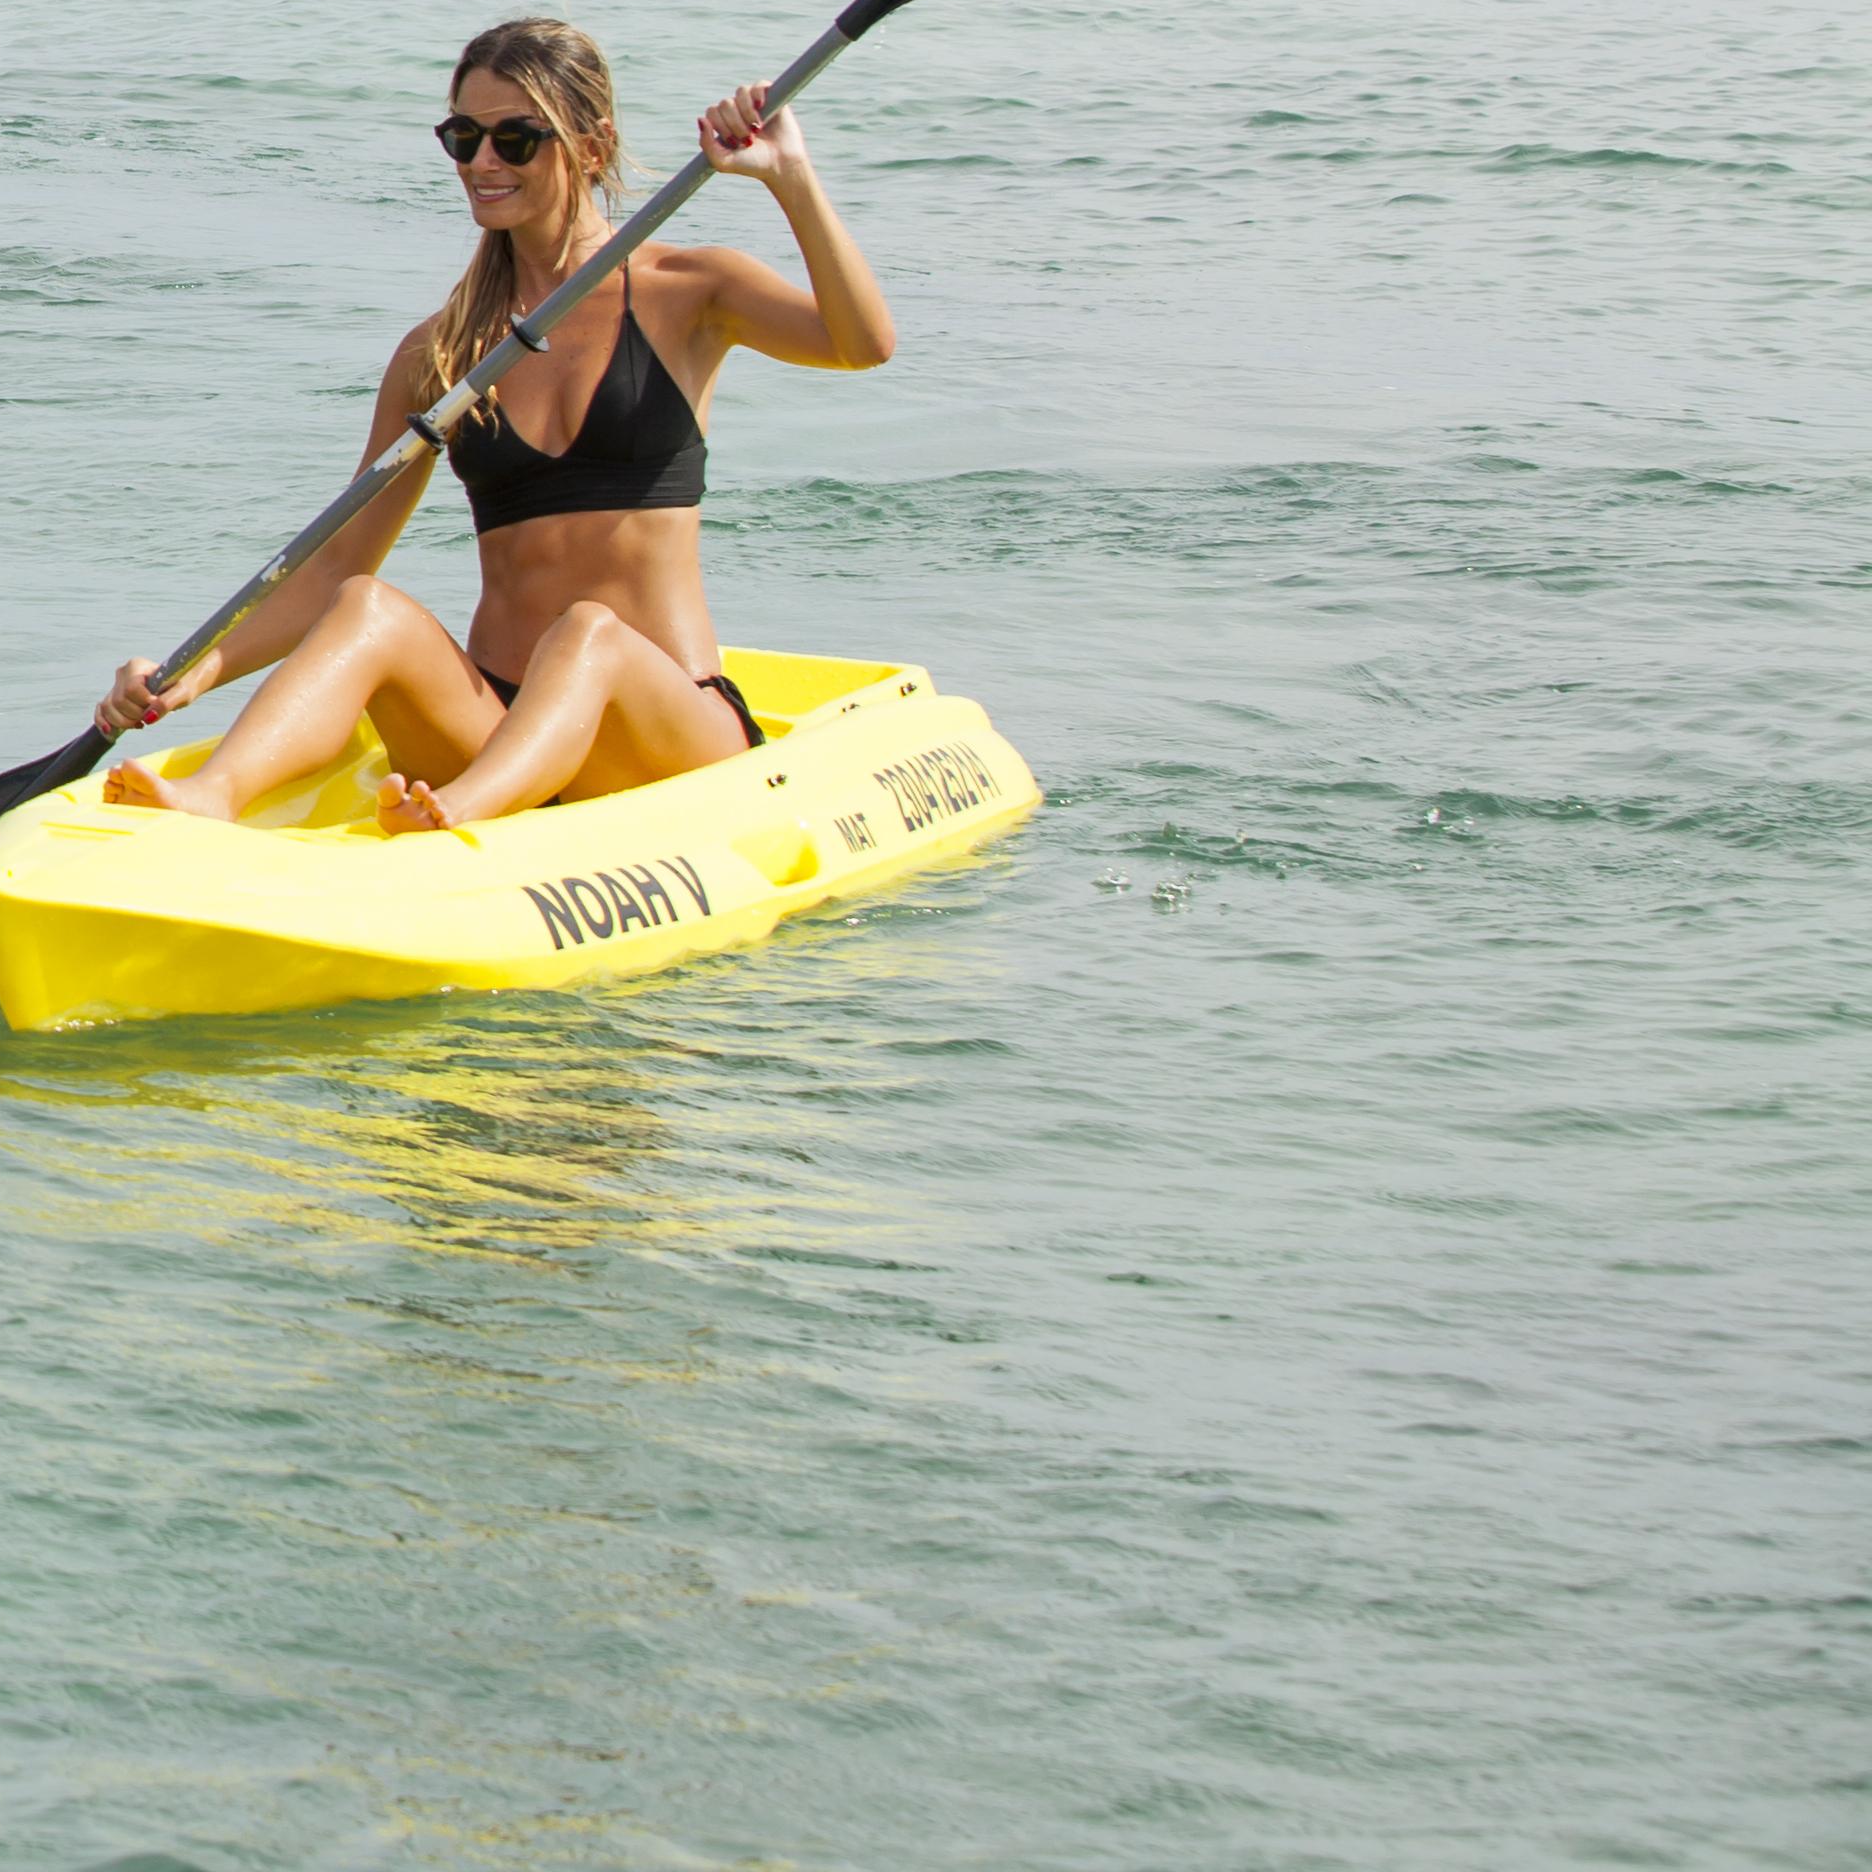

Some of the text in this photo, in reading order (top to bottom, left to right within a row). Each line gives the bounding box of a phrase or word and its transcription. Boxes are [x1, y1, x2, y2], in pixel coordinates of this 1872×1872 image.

[833, 812, 877, 853] MAT
[520, 855, 711, 951] NOAH V
